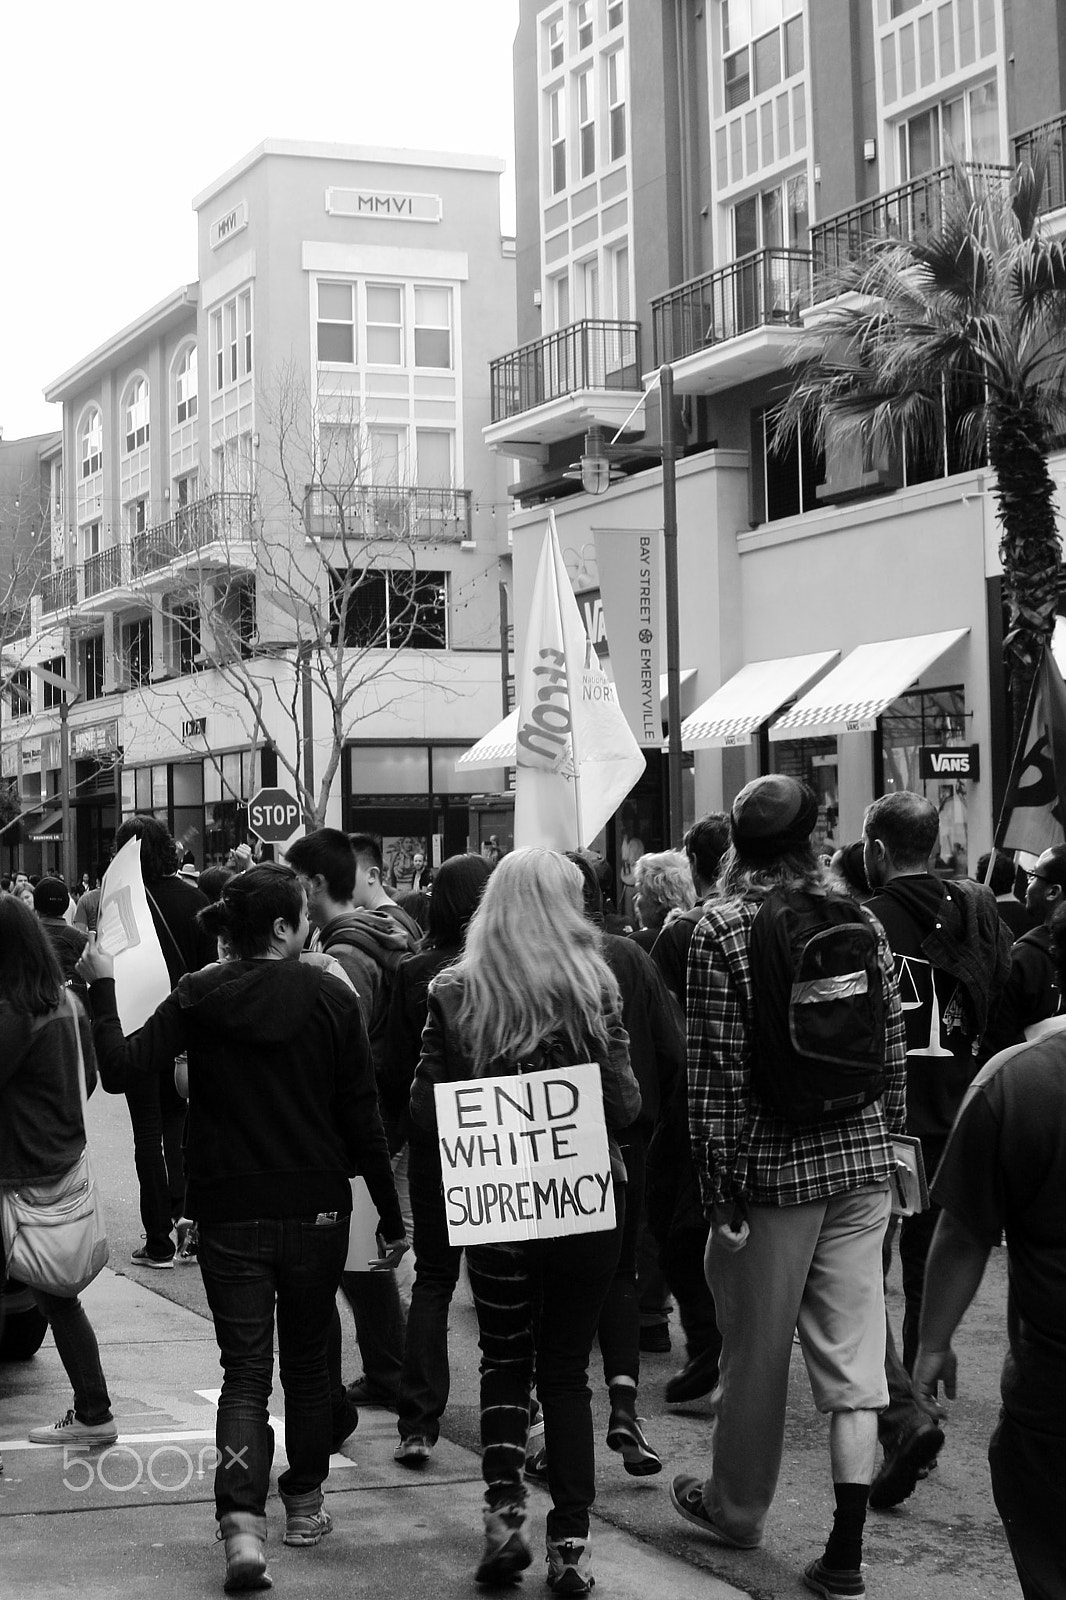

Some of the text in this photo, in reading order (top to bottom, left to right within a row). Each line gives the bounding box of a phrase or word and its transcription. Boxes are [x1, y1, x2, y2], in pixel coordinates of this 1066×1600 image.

[358, 195, 412, 214] MMVI
[218, 212, 237, 239] MMVI
[639, 536, 655, 740] BAY STREET EMERYVILLE
[846, 720, 860, 732] VANS
[725, 735, 736, 746] VANS
[930, 753, 970, 774] VANS
[252, 804, 298, 827] STOP
[454, 1079, 580, 1129] END
[441, 1123, 579, 1169] WHITE
[446, 1170, 612, 1227] SUPREMACY
